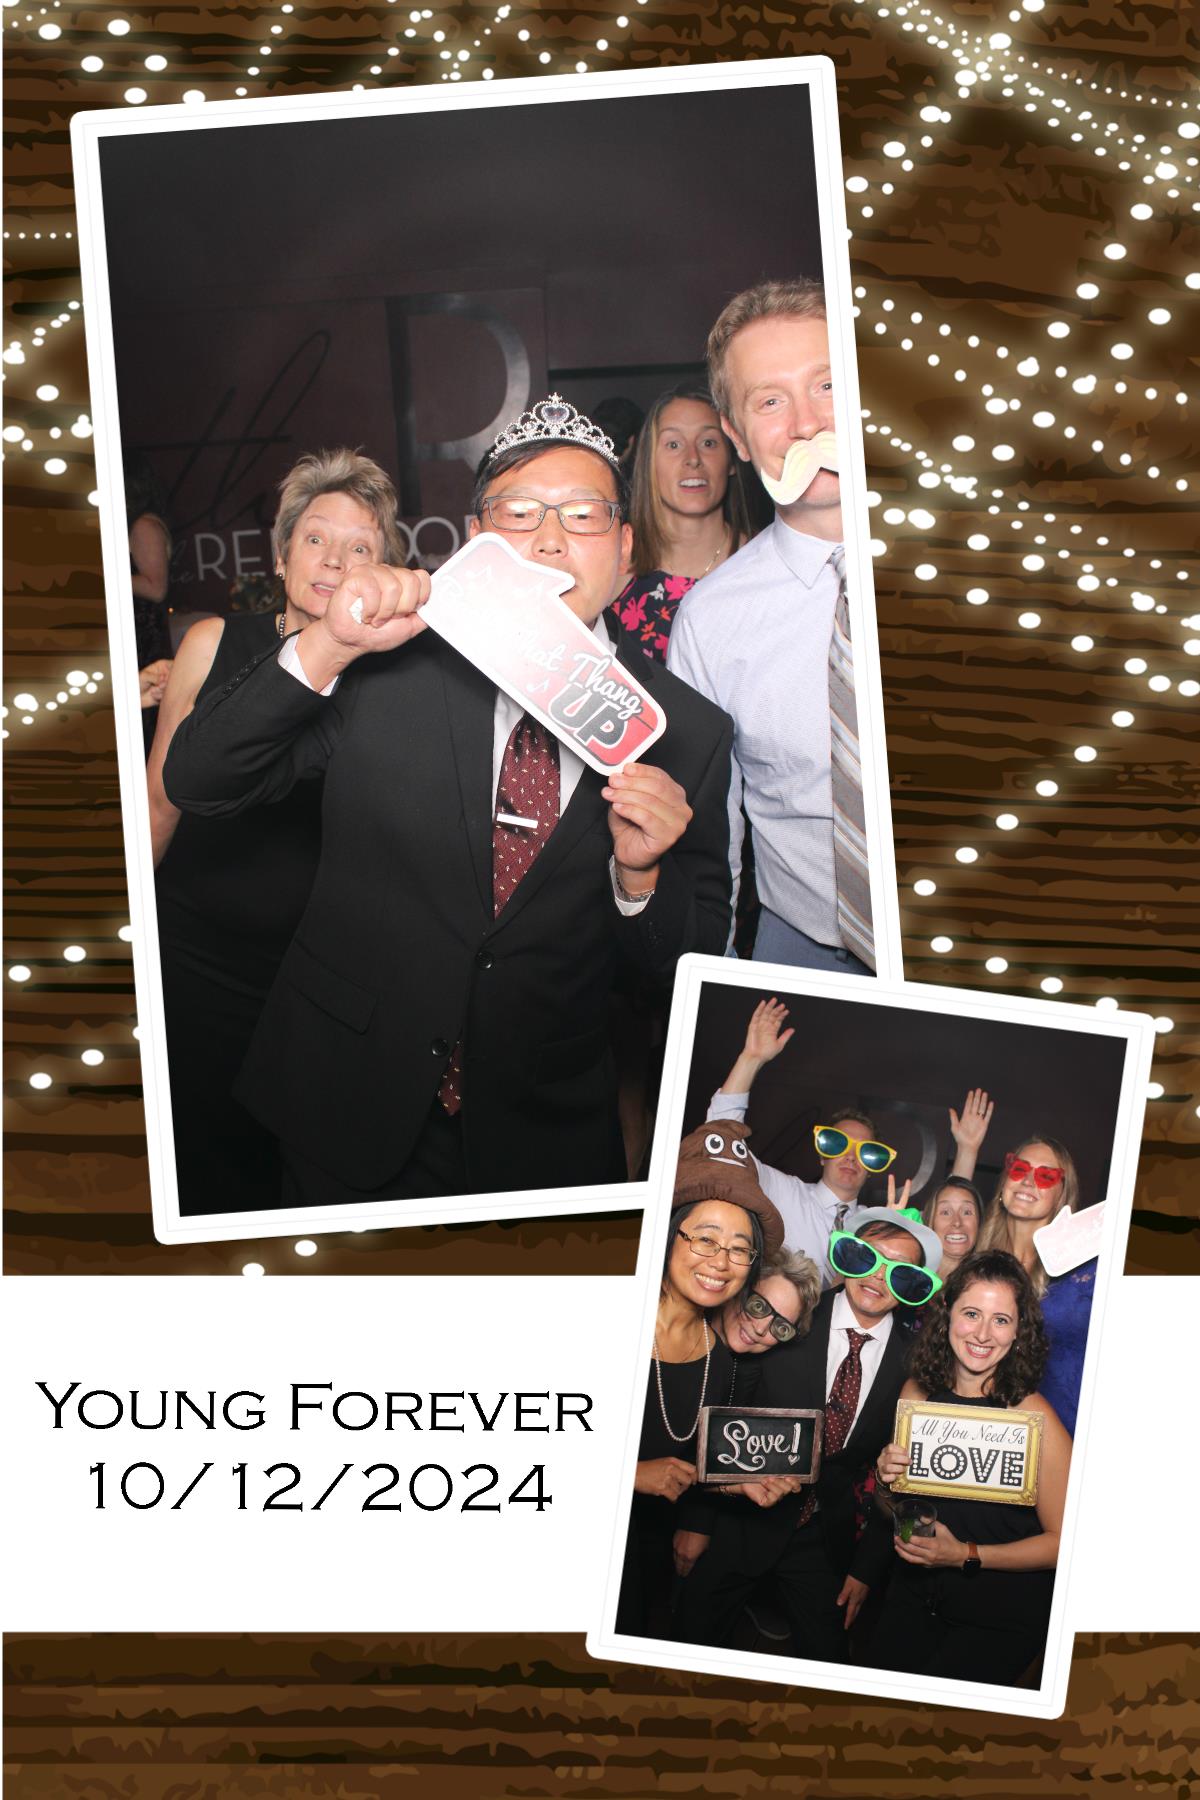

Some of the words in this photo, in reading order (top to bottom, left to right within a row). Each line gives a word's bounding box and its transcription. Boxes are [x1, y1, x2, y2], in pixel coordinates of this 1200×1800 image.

[193, 527, 277, 582] RE
[567, 652, 642, 720] Thang
[547, 682, 628, 748] UP
[717, 1420, 801, 1472] Love!
[912, 1419, 937, 1436] All
[938, 1420, 969, 1444] You
[971, 1424, 1008, 1443] Need
[1008, 1427, 1027, 1445] Is
[909, 1441, 1025, 1487] LOVE
